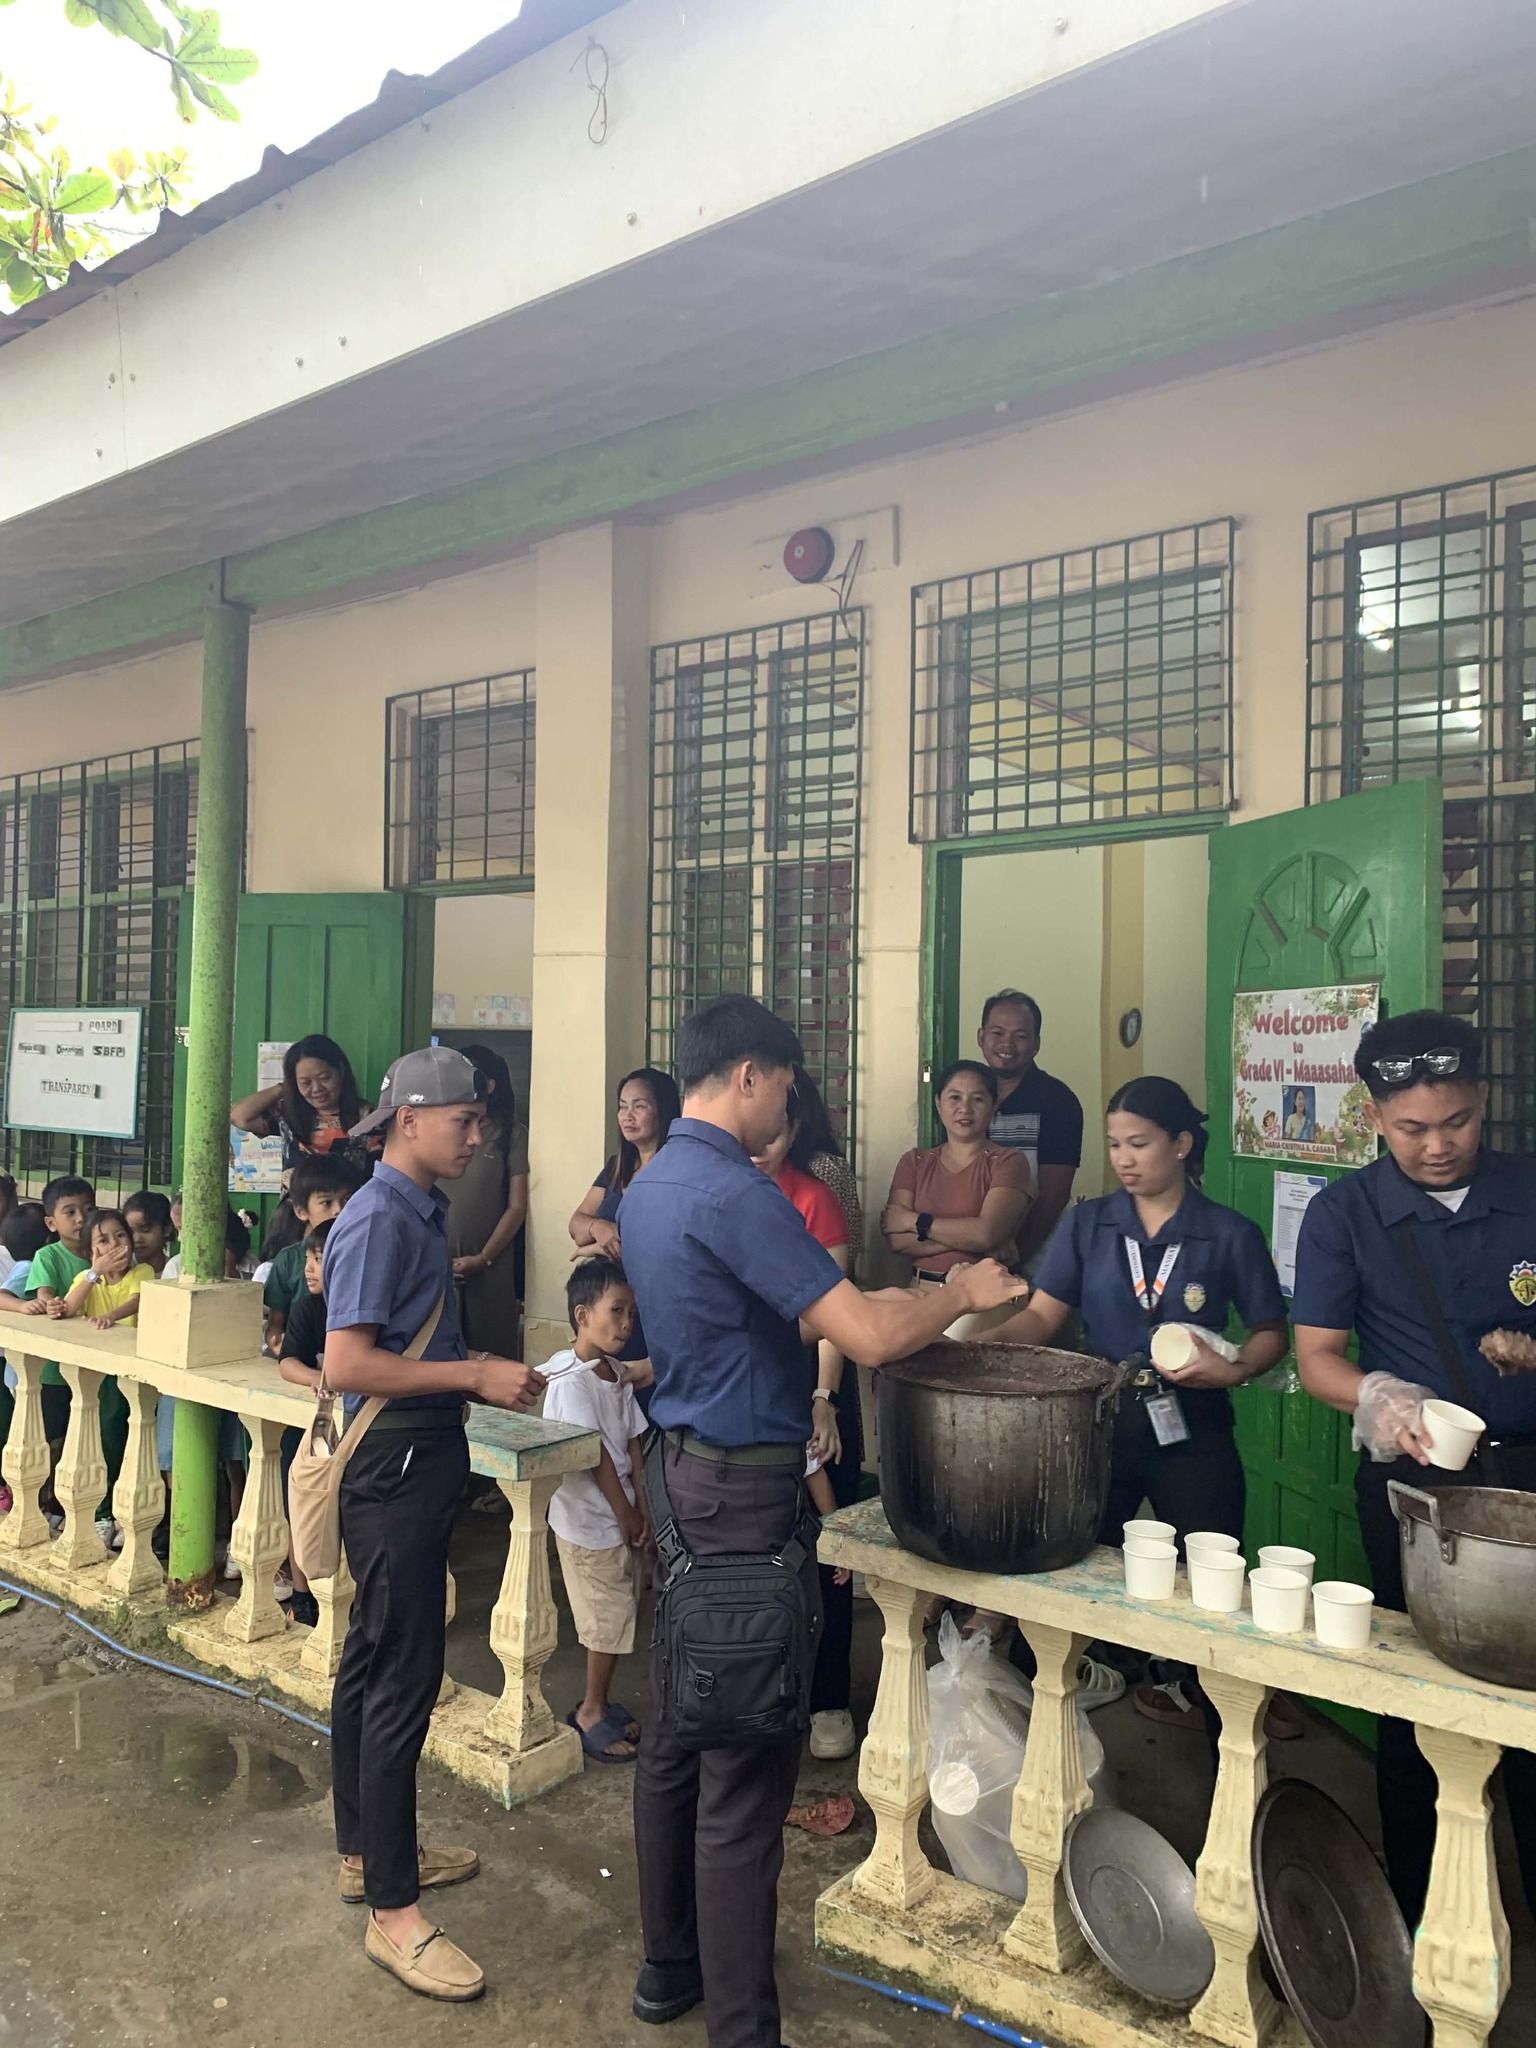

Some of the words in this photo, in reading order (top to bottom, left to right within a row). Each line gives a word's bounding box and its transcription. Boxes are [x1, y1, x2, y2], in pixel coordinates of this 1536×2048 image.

[1254, 1009, 1349, 1036] Welcome
[1293, 1041, 1304, 1054] to
[1240, 1058, 1272, 1082] Grade
[1274, 1059, 1284, 1082] VI
